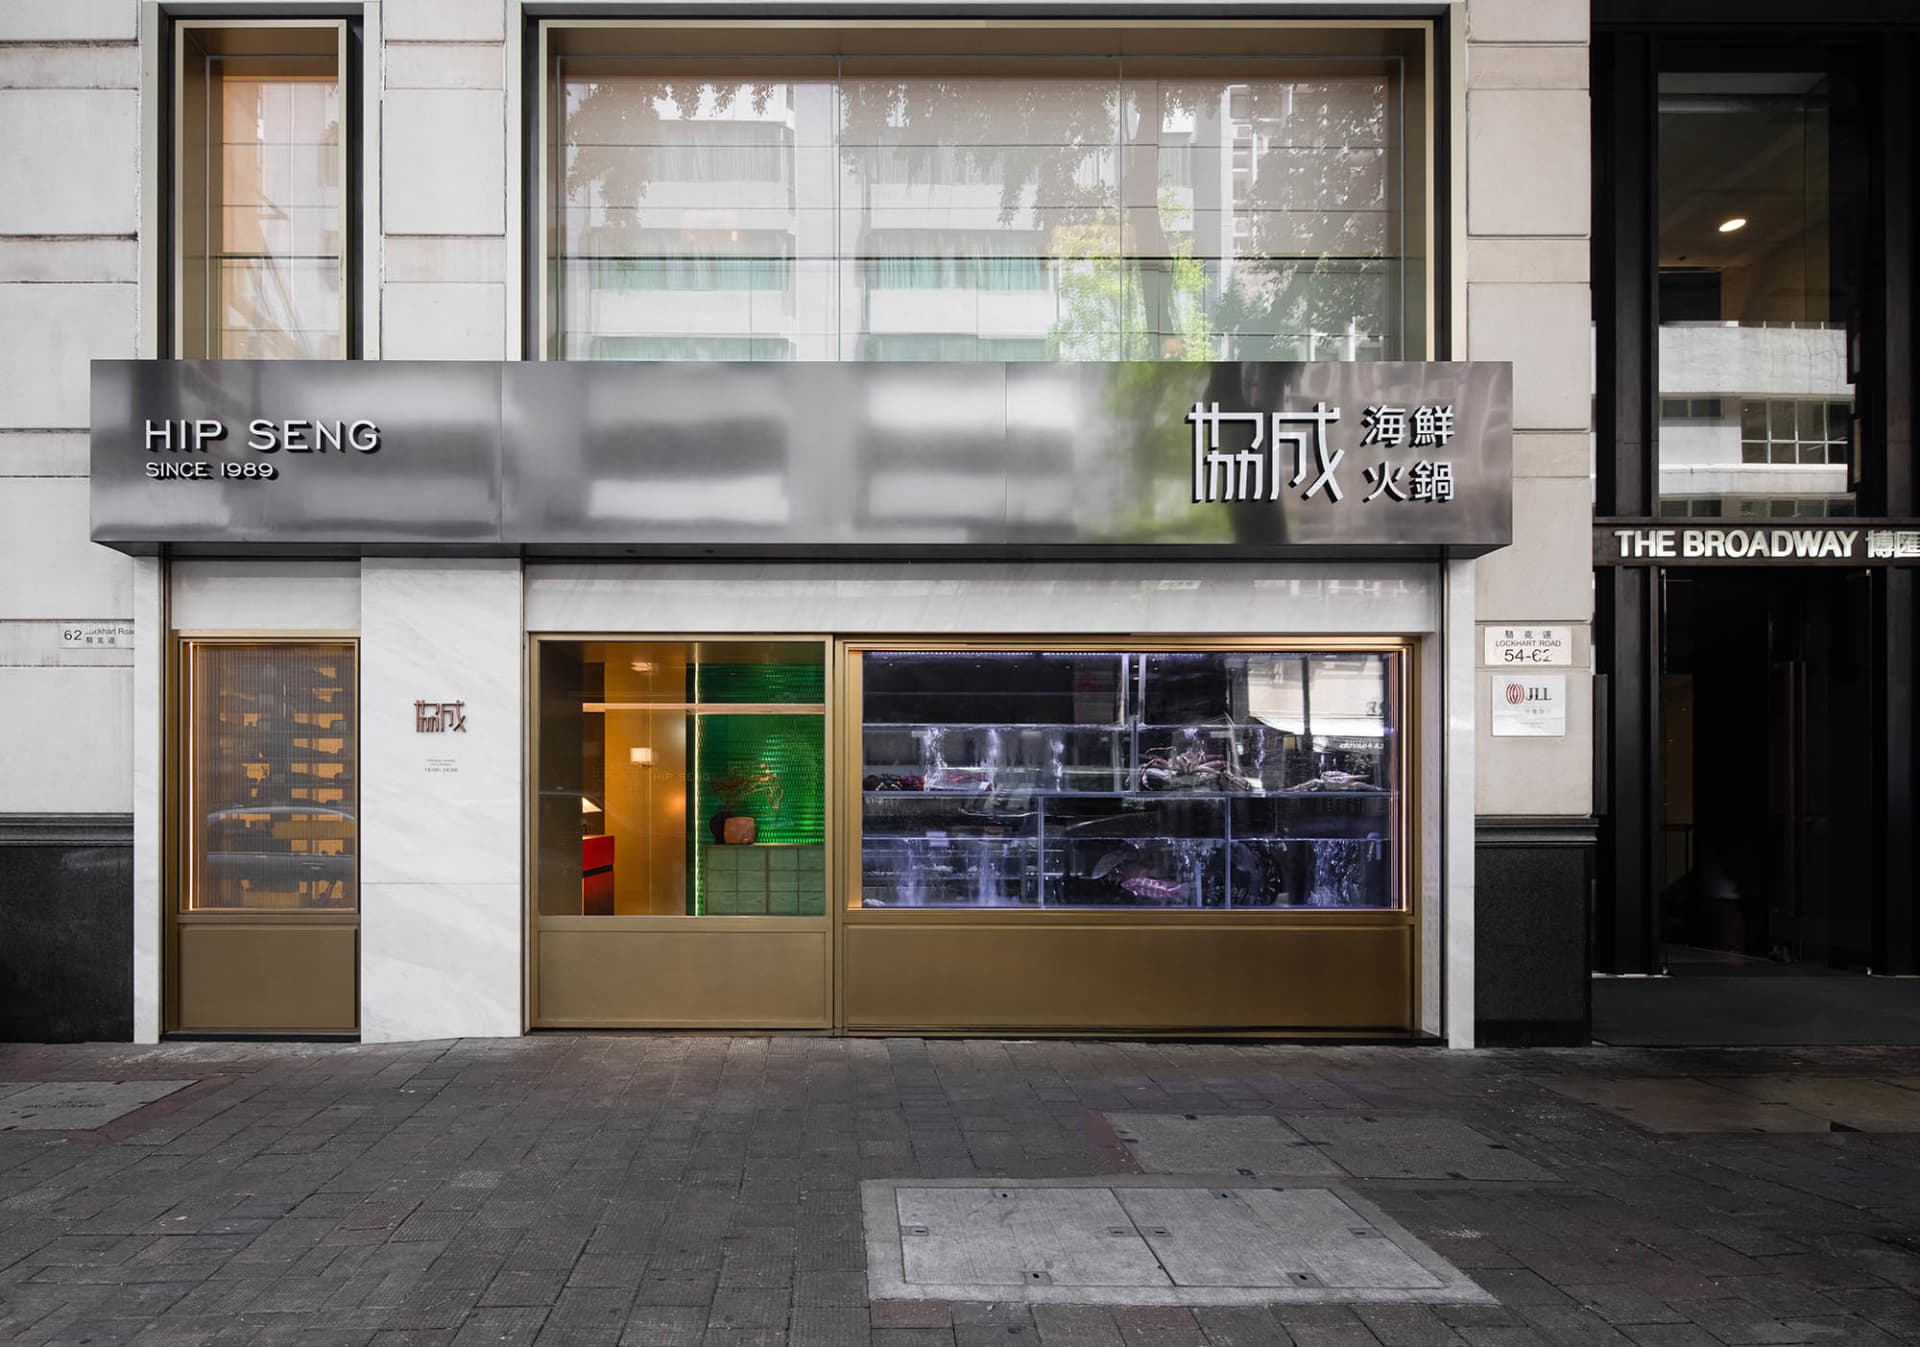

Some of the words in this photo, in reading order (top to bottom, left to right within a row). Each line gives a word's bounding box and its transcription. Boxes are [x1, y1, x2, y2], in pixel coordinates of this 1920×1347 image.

[145, 419, 226, 450] HIP
[248, 419, 379, 450] SENG
[1363, 405, 1455, 445] 海鮮
[145, 461, 207, 477] SINCE
[220, 461, 274, 477] 1989
[1363, 460, 1455, 500] 火鍋
[1615, 530, 1676, 557] THE
[1683, 530, 1858, 557] BROADWAY
[64, 629, 82, 641] 62
[1504, 649, 1552, 662] 54-62
[1526, 688, 1552, 701] JLL
